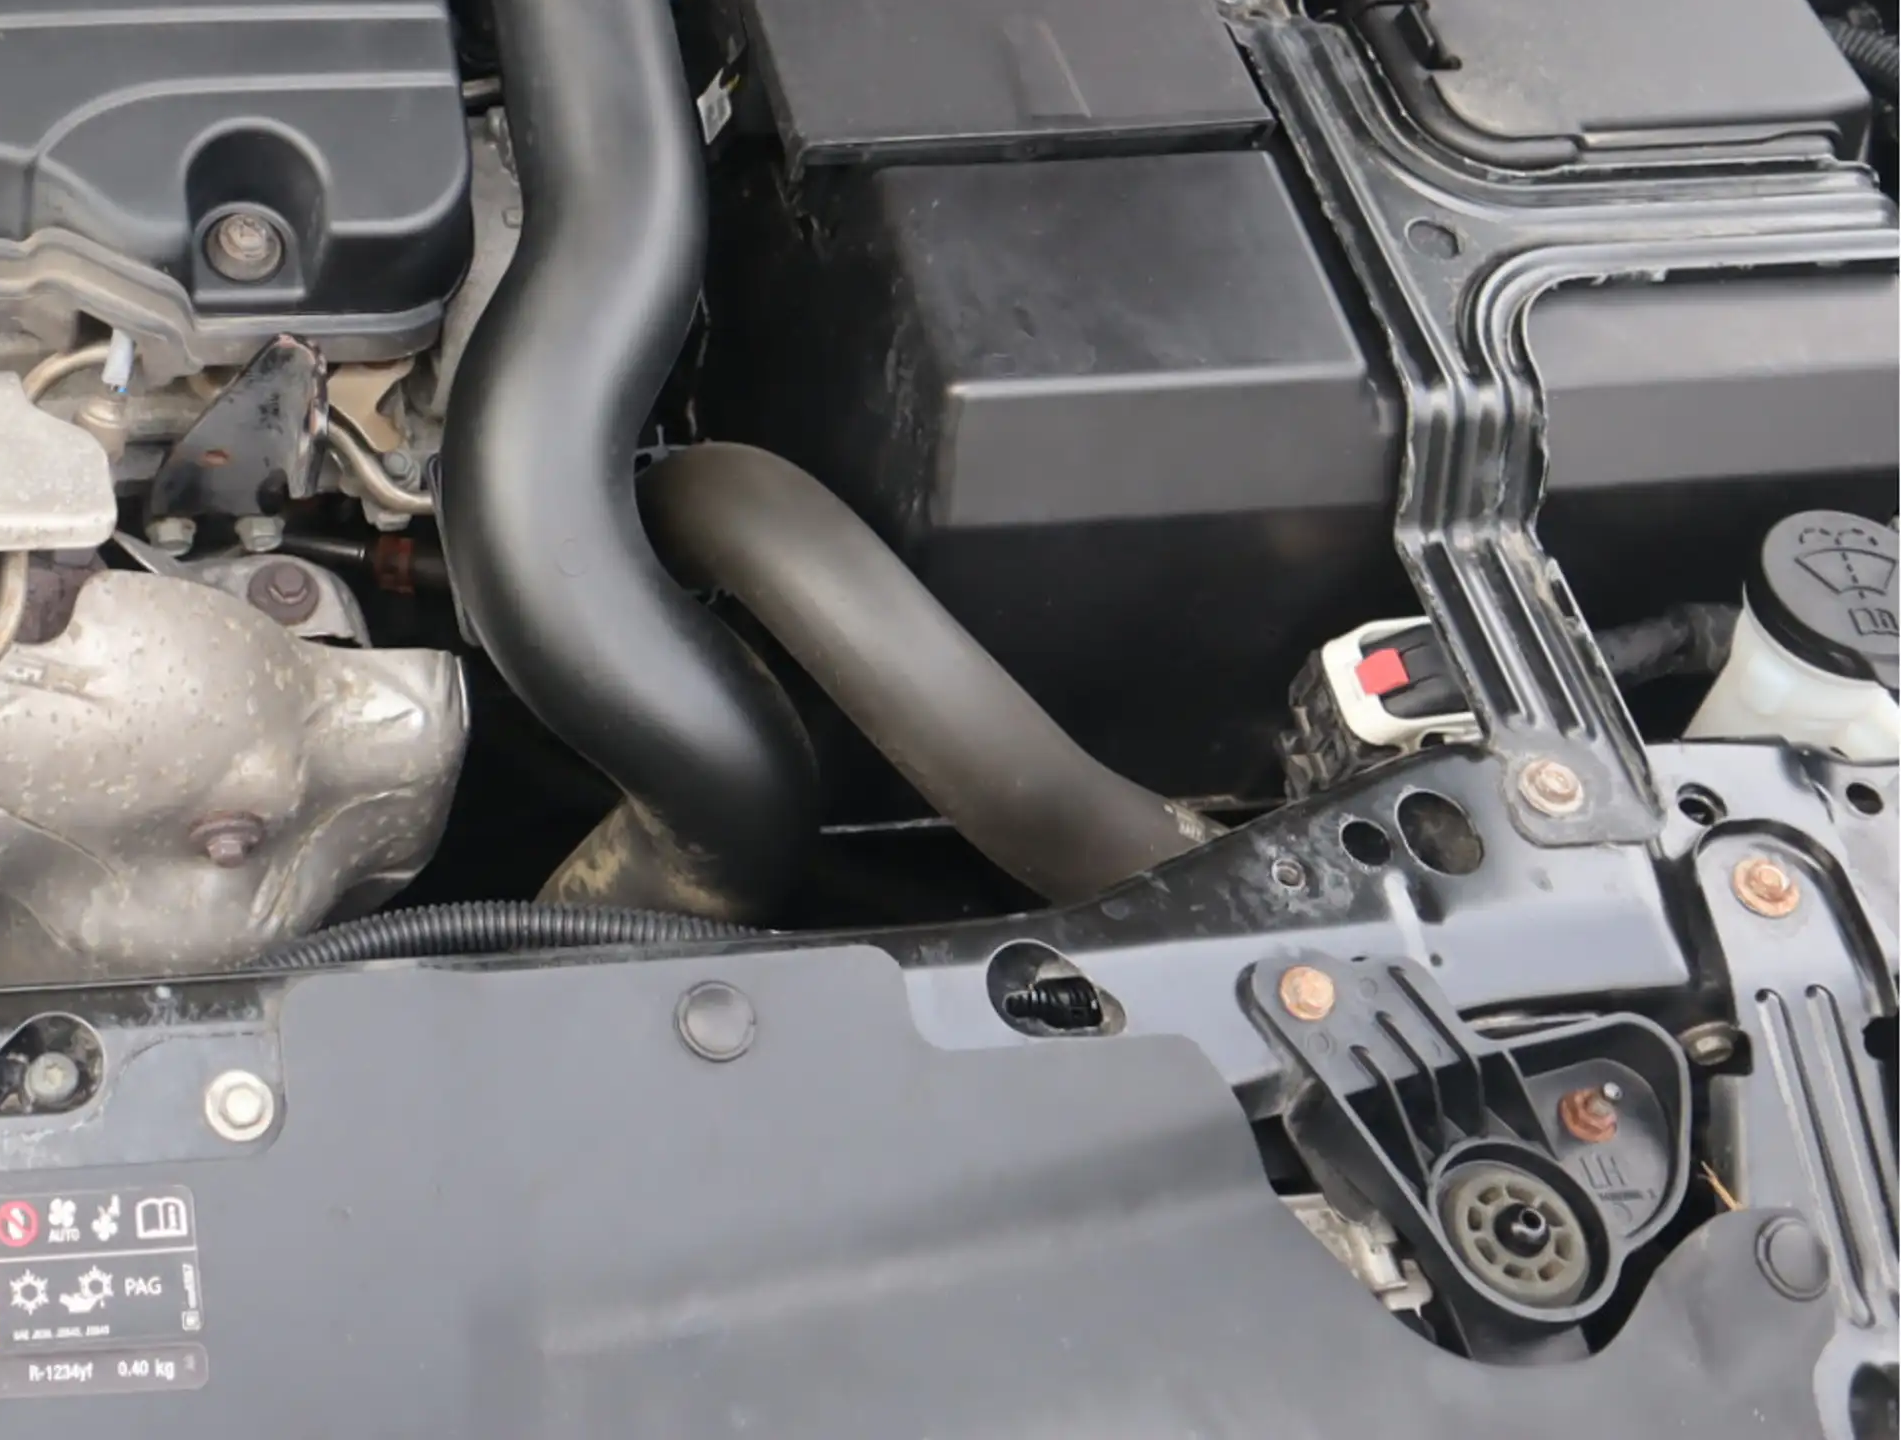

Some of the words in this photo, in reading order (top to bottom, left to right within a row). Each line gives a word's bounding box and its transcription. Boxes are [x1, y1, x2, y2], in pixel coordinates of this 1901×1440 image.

[124, 1277, 162, 1296] PAG
[117, 1359, 149, 1377] 0.40
[155, 1358, 175, 1381] kg
